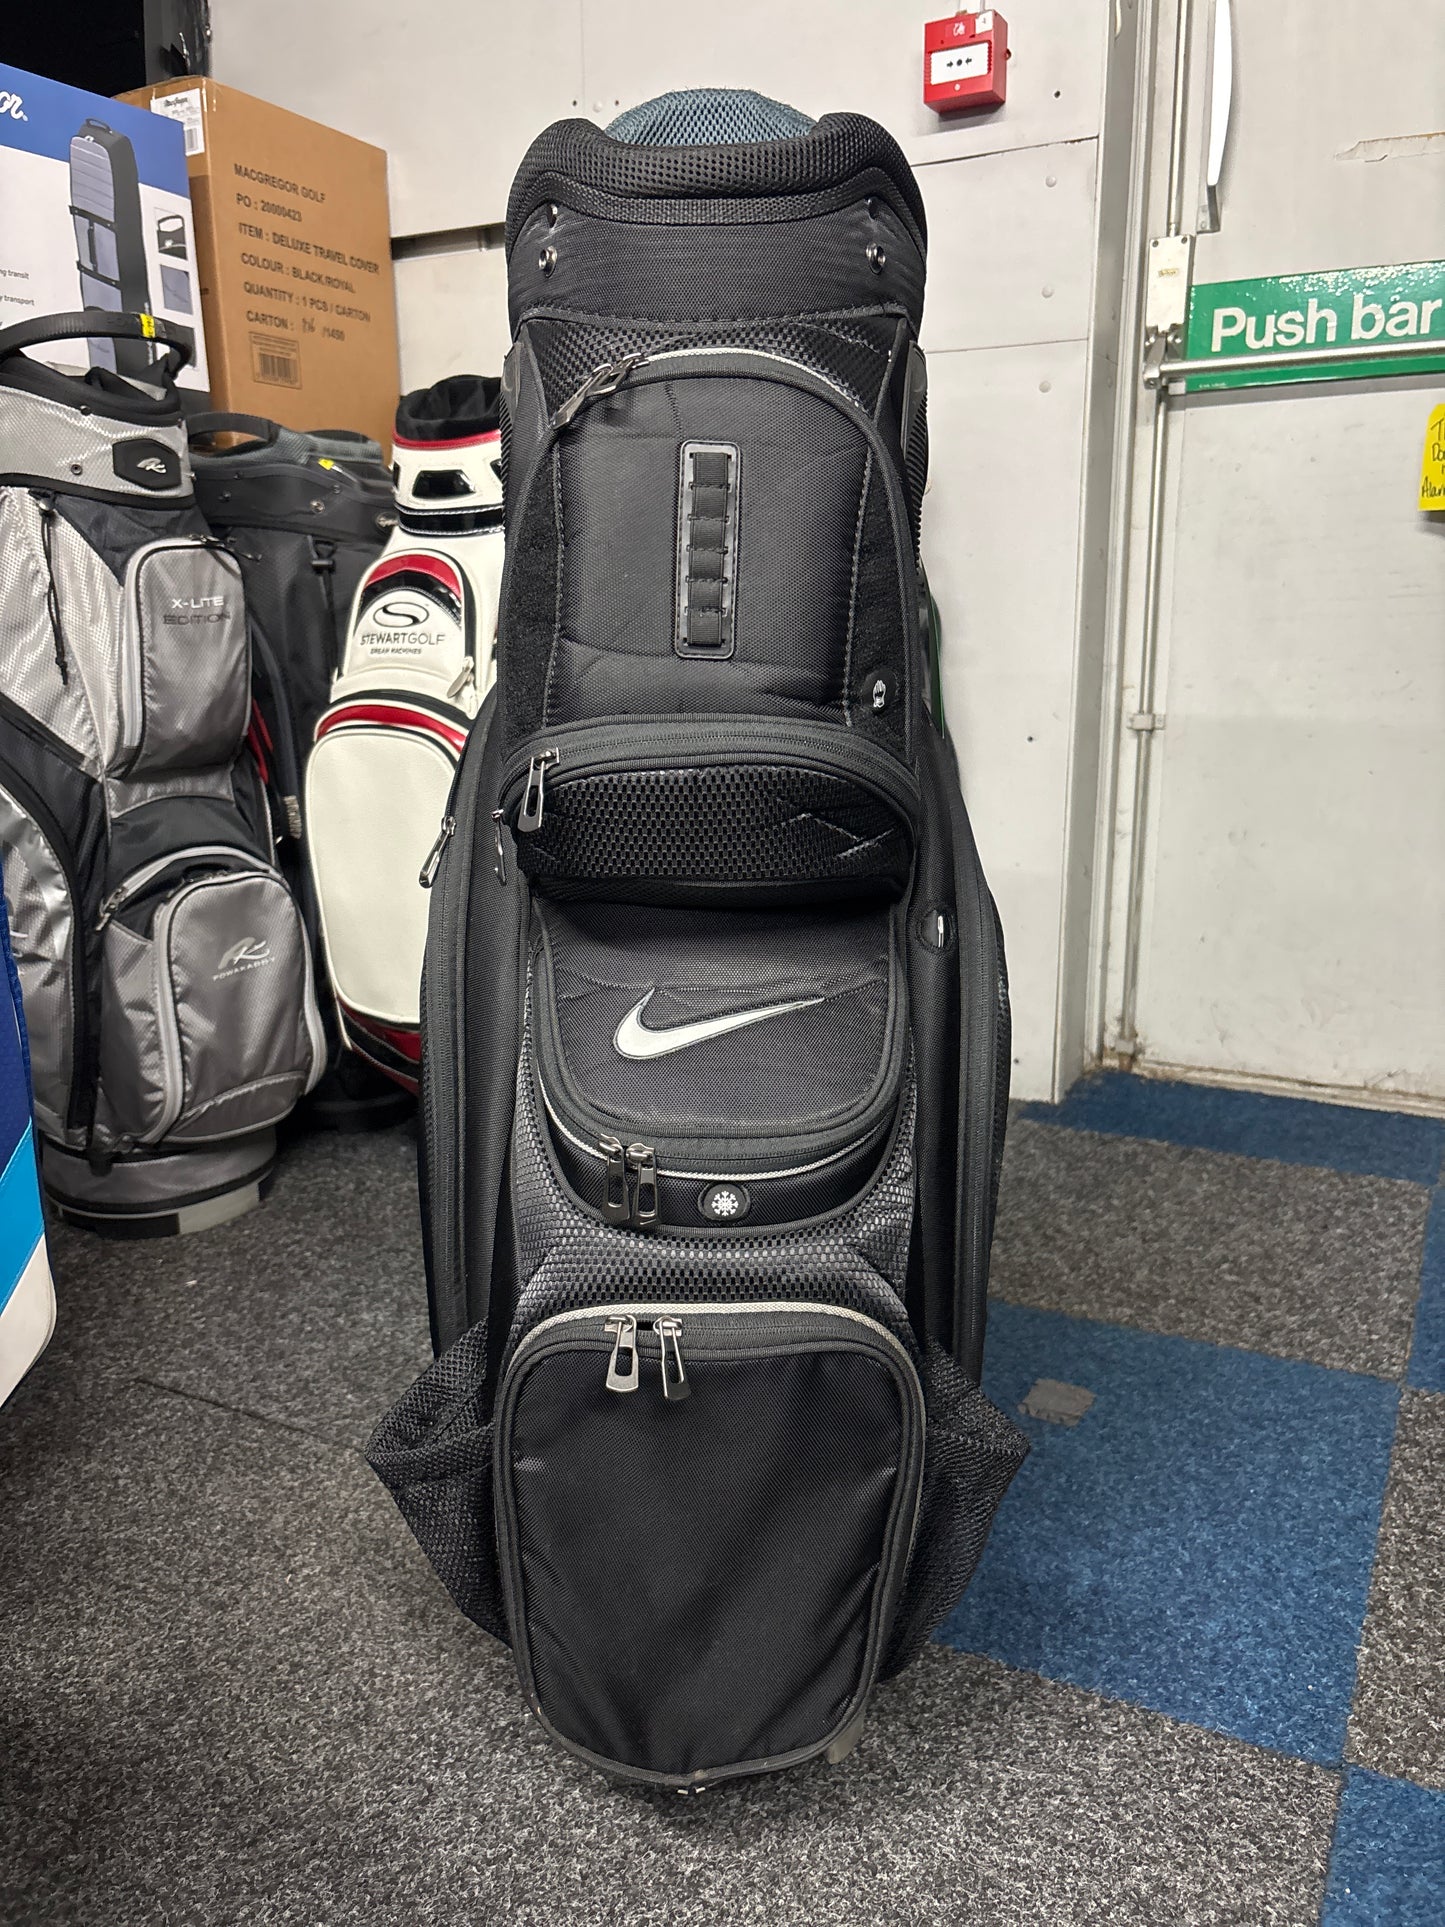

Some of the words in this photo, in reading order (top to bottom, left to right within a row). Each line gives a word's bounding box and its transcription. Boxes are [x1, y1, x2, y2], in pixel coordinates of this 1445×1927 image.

[234, 163, 299, 196] MACGREGOR
[301, 186, 326, 203] GOLF
[236, 193, 251, 207] PO
[238, 222, 263, 240] ITEM
[272, 232, 311, 255] DELUXE
[313, 244, 348, 266] TRAVEL
[350, 256, 379, 274] COVER
[8, 269, 29, 280] transit
[240, 252, 284, 275] COLOUR
[243, 281, 293, 304] QUANTITY
[309, 298, 328, 312] PCS
[335, 304, 371, 322] CARTON
[246, 310, 288, 330] CARTON
[1211, 299, 1338, 352] Push
[1351, 293, 1443, 341] bar
[171, 596, 224, 609] X-LITE
